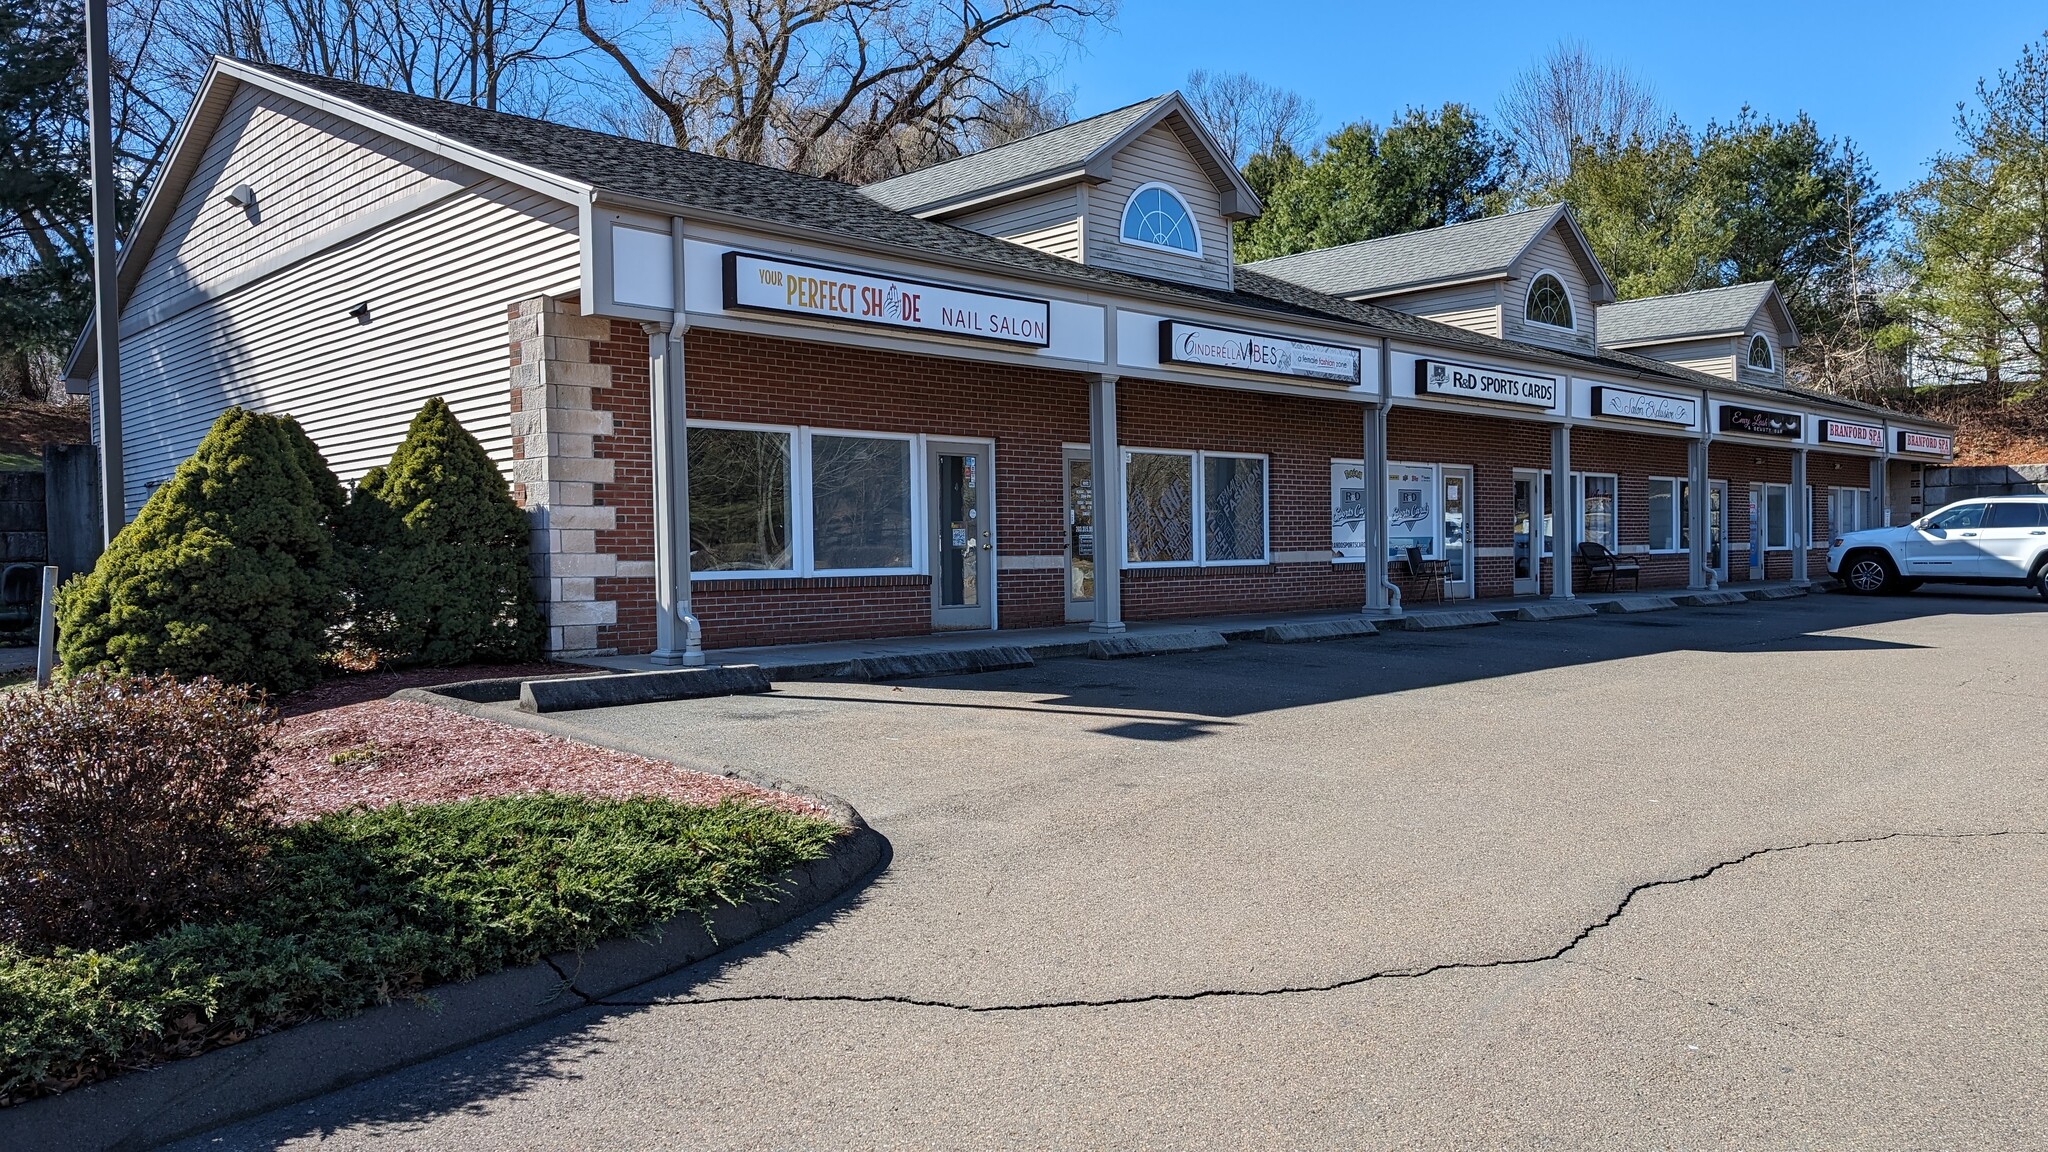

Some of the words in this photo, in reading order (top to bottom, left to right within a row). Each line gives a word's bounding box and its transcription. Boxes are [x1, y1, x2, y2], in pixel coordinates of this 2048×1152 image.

[758, 269, 783, 287] YOUR
[786, 274, 857, 314] PERFECT
[942, 307, 982, 330] NAIL
[989, 315, 1044, 339] SALON
[1302, 354, 1318, 364] female
[1318, 357, 1335, 367] fashion
[1335, 361, 1347, 369] zone
[1453, 371, 1477, 390] R&D
[1480, 376, 1519, 396] SPORTS
[1521, 382, 1552, 400] CARDS
[1624, 395, 1645, 415] Salon
[1829, 423, 1867, 440] BRANFORD
[1868, 429, 1882, 442] SPA
[1907, 434, 1938, 450] BRANFORD
[1938, 438, 1949, 451] SPA
[1223, 465, 1261, 517] FASHION
[1345, 491, 1361, 501] R&D
[1403, 492, 1417, 502] R&D
[1153, 477, 1189, 529] LOVE
